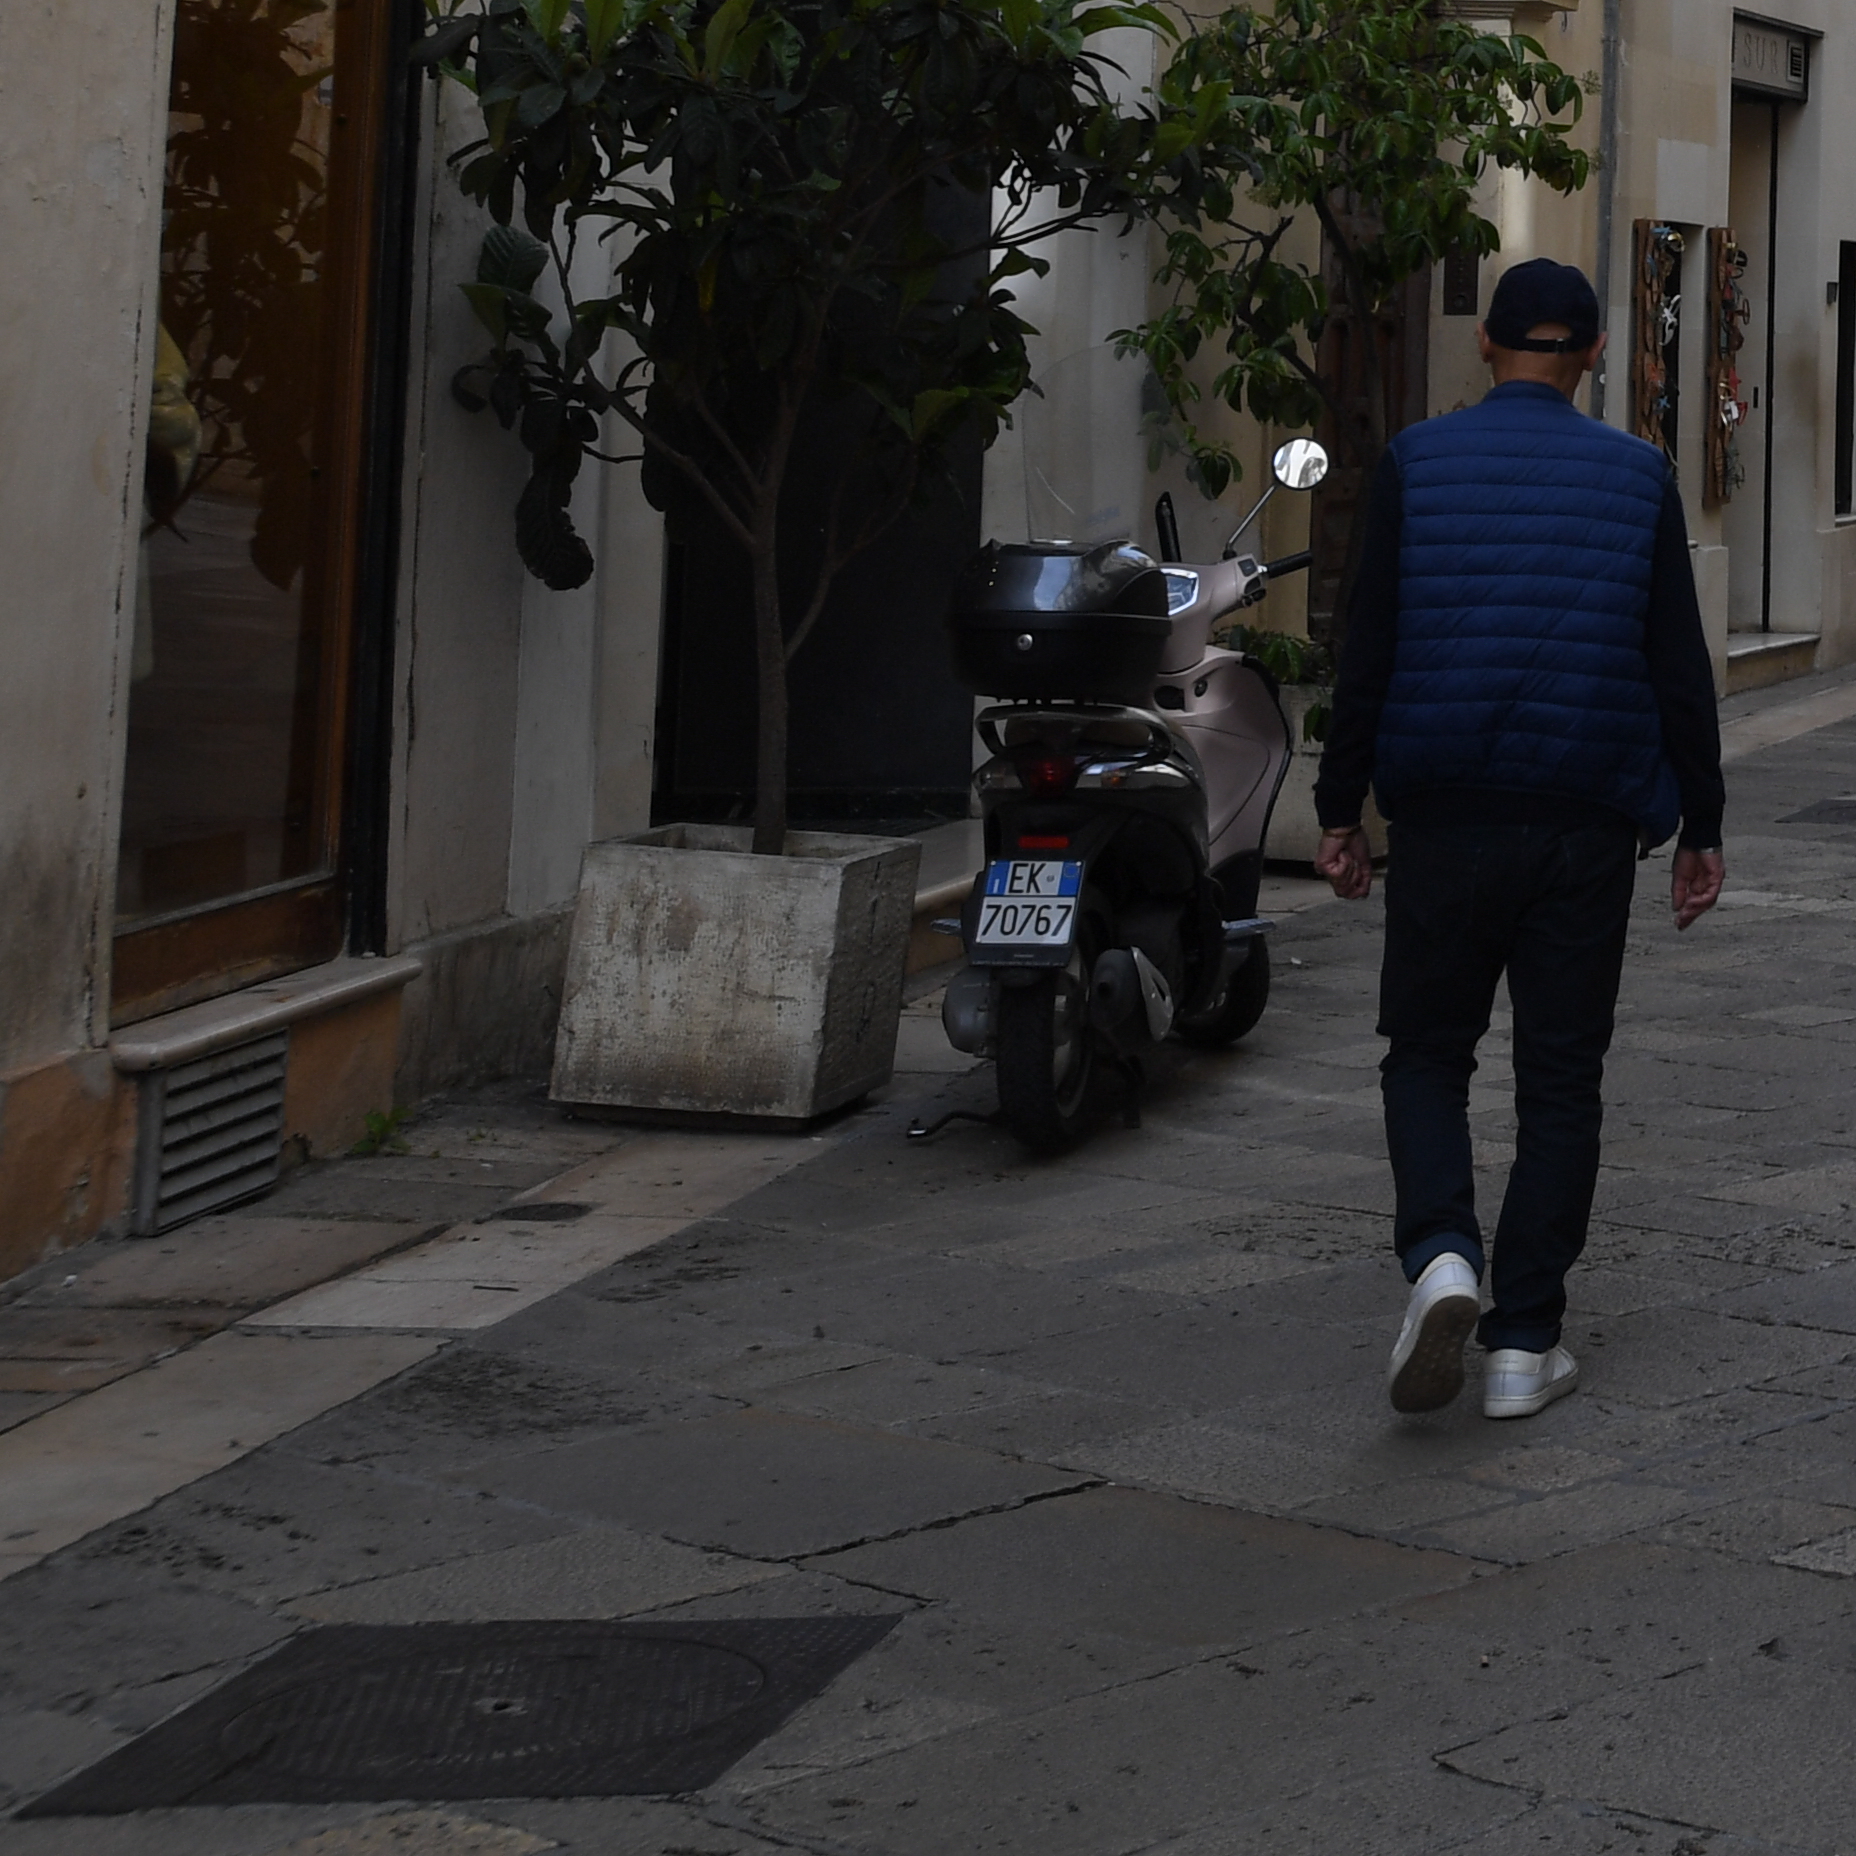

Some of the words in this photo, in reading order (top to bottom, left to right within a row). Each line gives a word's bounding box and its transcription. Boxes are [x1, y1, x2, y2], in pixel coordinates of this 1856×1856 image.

[1743, 32, 1778, 74] SUR
[1008, 862, 1046, 894] EK
[981, 904, 1072, 937] 70767
